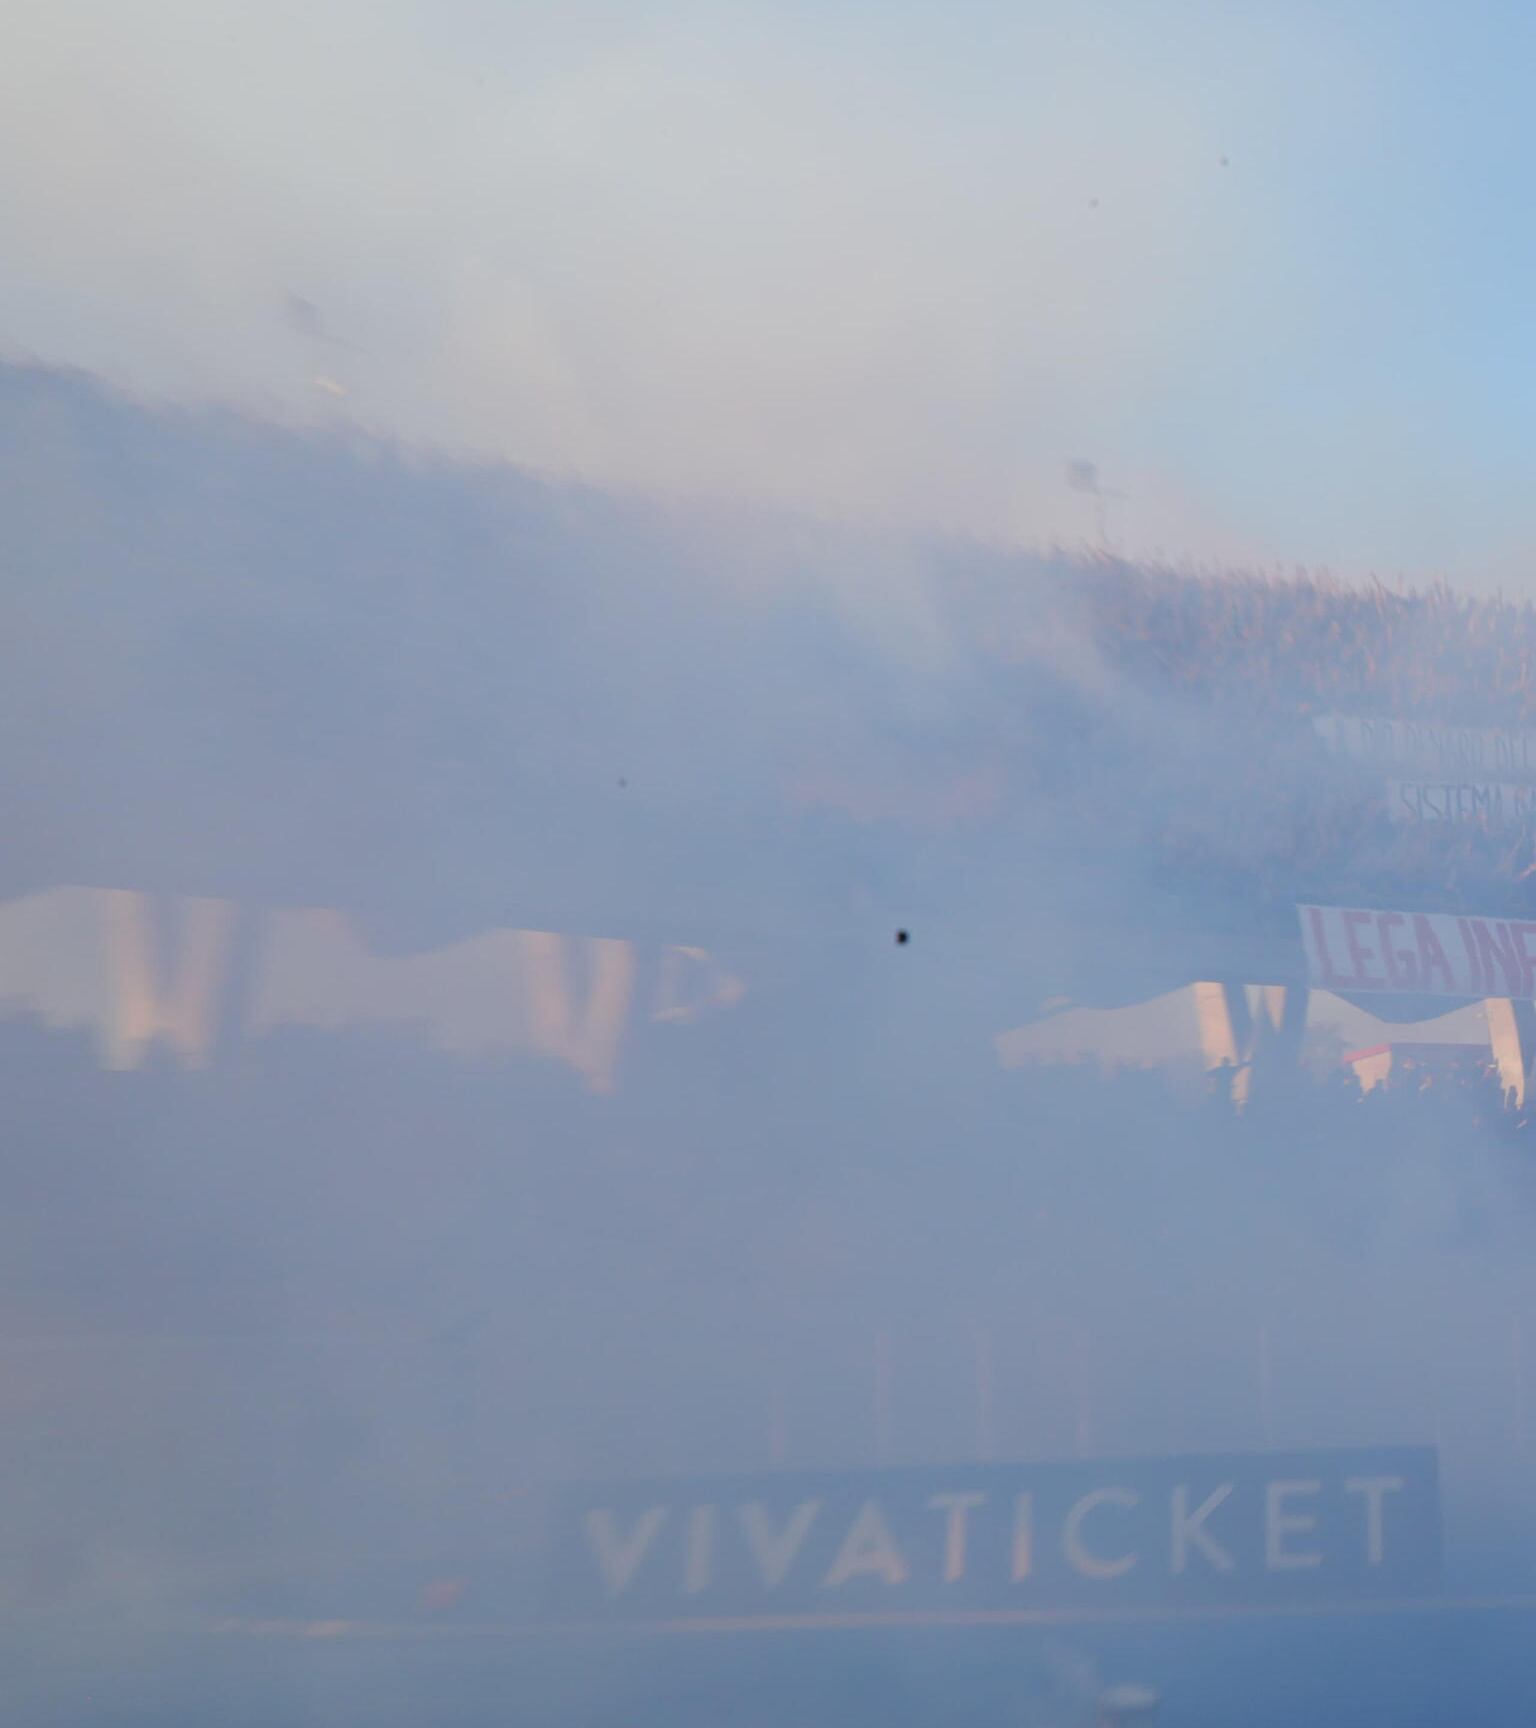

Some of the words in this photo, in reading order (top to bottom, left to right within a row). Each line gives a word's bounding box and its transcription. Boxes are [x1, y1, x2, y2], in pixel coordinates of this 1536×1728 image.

[1401, 783, 1504, 824] SISTEMA
[1306, 907, 1457, 992] LEGA
[582, 1474, 1405, 1599] VIVATICKET
